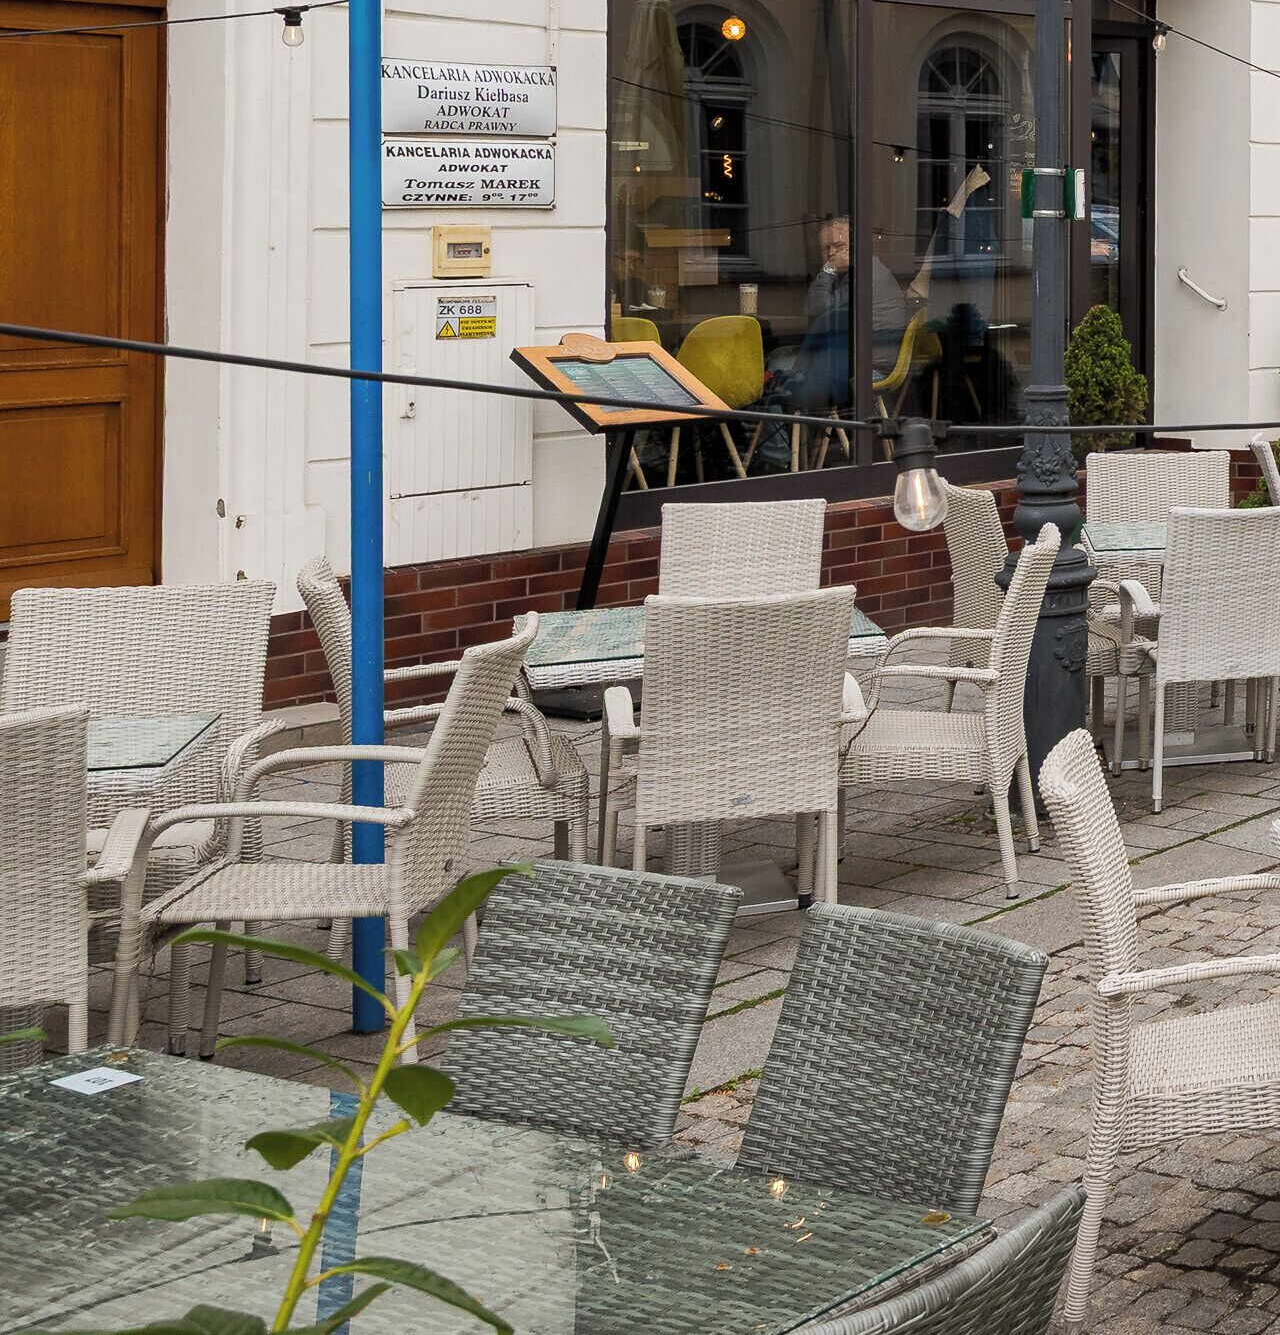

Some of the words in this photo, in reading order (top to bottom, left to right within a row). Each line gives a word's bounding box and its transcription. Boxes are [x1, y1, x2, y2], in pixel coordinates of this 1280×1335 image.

[381, 65, 470, 83] KANCELARIA
[474, 69, 555, 87] ADWOKACKA
[417, 85, 471, 101] Dariusz
[475, 87, 529, 103] Kiełbasa
[437, 105, 510, 119] ADWOKAT
[424, 120, 465, 131] RADCA
[468, 122, 517, 132] PRAWNY
[386, 146, 470, 158] KANCELARIA
[474, 148, 552, 160] ADWOKACKA
[438, 164, 508, 173] ADWOKAT
[404, 179, 475, 189] Tomasz
[480, 179, 541, 190] MAREK
[402, 193, 473, 202] CZYNNE:
[438, 305, 456, 315] ZK
[459, 305, 482, 315] 688
